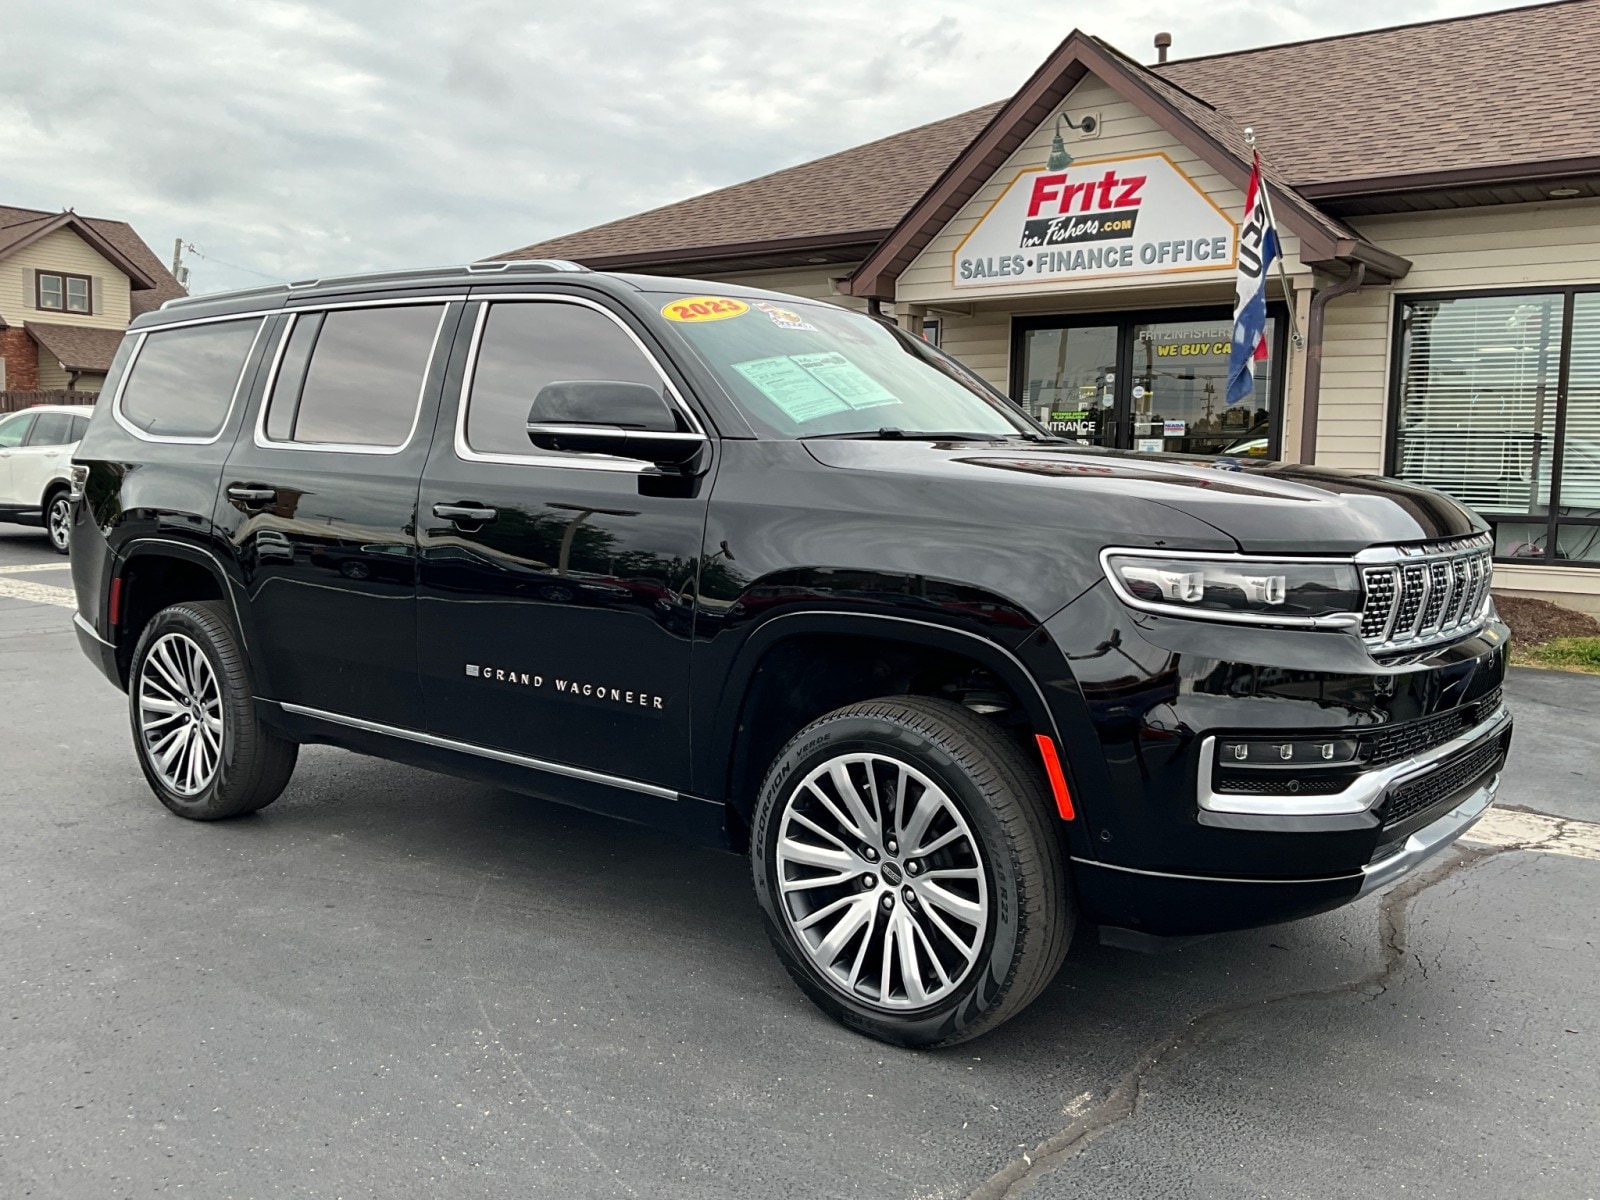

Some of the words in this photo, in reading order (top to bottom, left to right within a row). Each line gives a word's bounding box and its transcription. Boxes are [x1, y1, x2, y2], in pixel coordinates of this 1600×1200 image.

[1027, 170, 1147, 217] Fritz
[960, 255, 1025, 280] SALES
[1036, 246, 1133, 273] FINANCE
[1140, 237, 1227, 264] OFFICE
[672, 299, 741, 320] 2023
[1139, 329, 1233, 342] FRITZINFISHERS
[1157, 344, 1178, 357] WE
[1180, 343, 1208, 356] BUY
[1212, 342, 1232, 355] CA
[483, 667, 543, 687] GRAND
[555, 679, 663, 709] WAGONEER
[756, 761, 790, 860] SCORPION
[796, 733, 831, 757] VERDE
